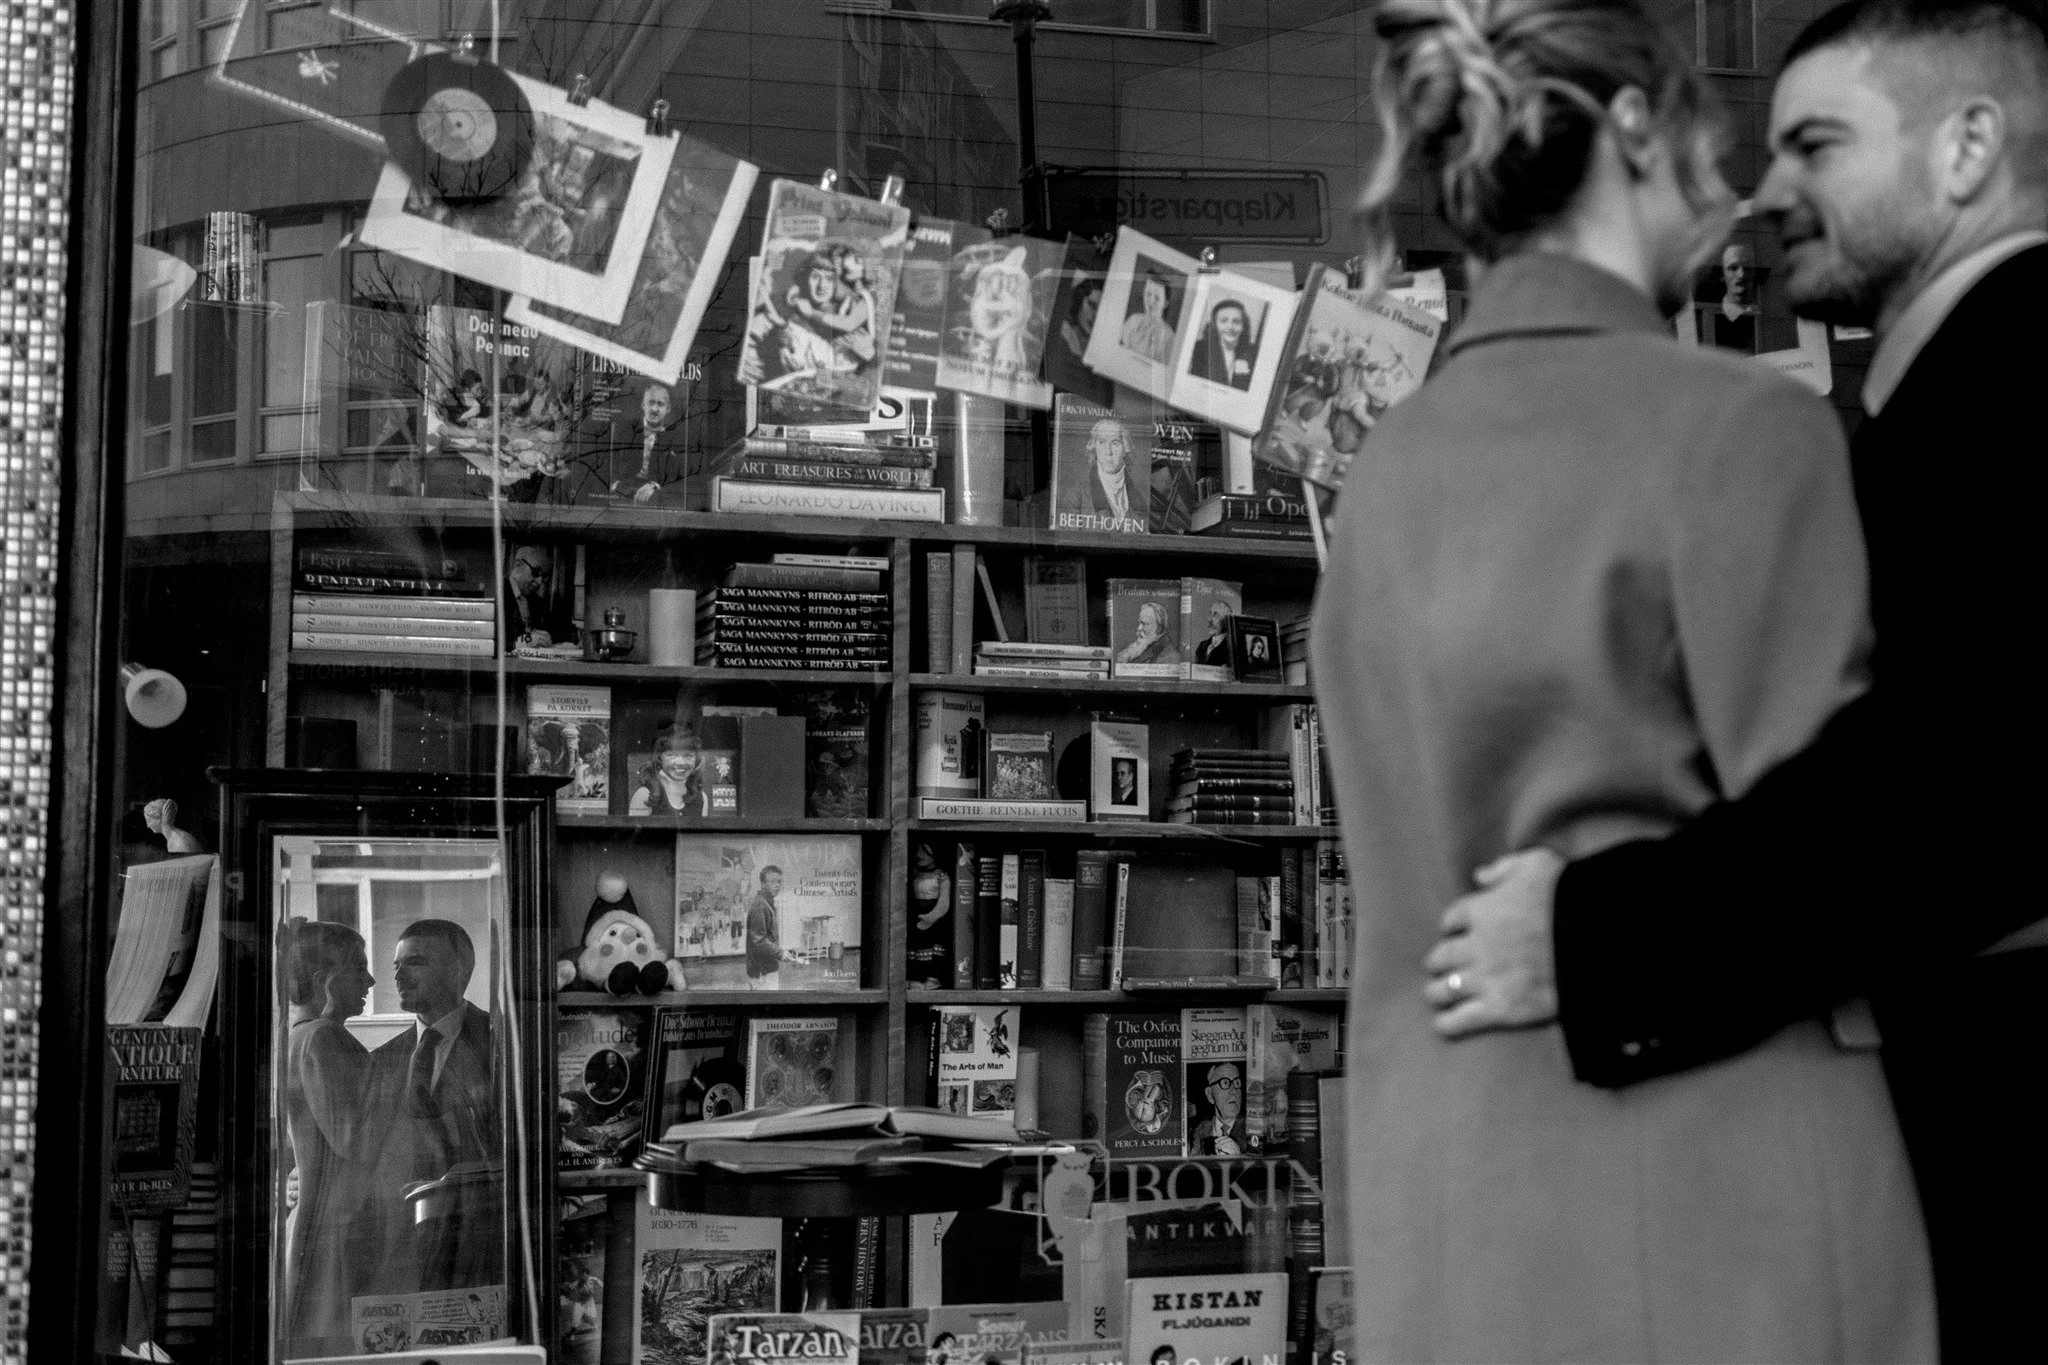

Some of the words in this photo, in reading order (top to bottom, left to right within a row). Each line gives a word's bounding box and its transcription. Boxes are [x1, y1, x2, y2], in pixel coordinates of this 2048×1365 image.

[469, 315, 539, 340] Doineau
[740, 462, 767, 475] ART
[773, 463, 852, 480] TREASURES
[866, 469, 919, 483] WORLD
[740, 492, 843, 509] LEONARDO
[850, 496, 873, 510] DA
[878, 499, 928, 513] VINCI
[1266, 497, 1313, 522] Ope
[1060, 512, 1145, 533] BEETHOVEN
[722, 588, 745, 596] SAGA
[747, 589, 800, 599] MANNKYNS
[844, 593, 857, 602] AB
[722, 603, 745, 611] SAGA
[748, 604, 801, 614] MANNKYNS
[844, 608, 857, 616] AB
[722, 618, 745, 627] SAGA
[748, 619, 801, 628] MANNKYNS
[844, 622, 857, 630] AB
[721, 630, 744, 639] SAGA
[746, 632, 798, 641] MANNKYNS
[842, 634, 855, 643] AB
[719, 645, 743, 653] SAGA
[745, 645, 798, 655] MANNKYNS
[842, 648, 854, 657] AB
[724, 658, 747, 666] SAGA
[749, 659, 802, 668] MANNKYNS
[846, 661, 859, 669] AB
[937, 804, 983, 815] GOETHE
[990, 806, 1039, 816] REINEKE
[1043, 807, 1079, 817] FUCHS
[799, 879, 858, 890] Contemporary
[832, 887, 858, 898] Artists
[1114, 1019, 1141, 1034] The
[1116, 1034, 1182, 1051] Companion
[1123, 1053, 1137, 1065] to
[1142, 1051, 1176, 1065] Music
[977, 1062, 986, 1070] of
[1114, 1139, 1139, 1148] PERCY
[1147, 1138, 1183, 1147] SCHOLES
[855, 1246, 866, 1293] HISTORY
[1152, 1290, 1264, 1312] KISTAN
[860, 1321, 928, 1349] arza
[734, 1325, 847, 1360] Tarzan
